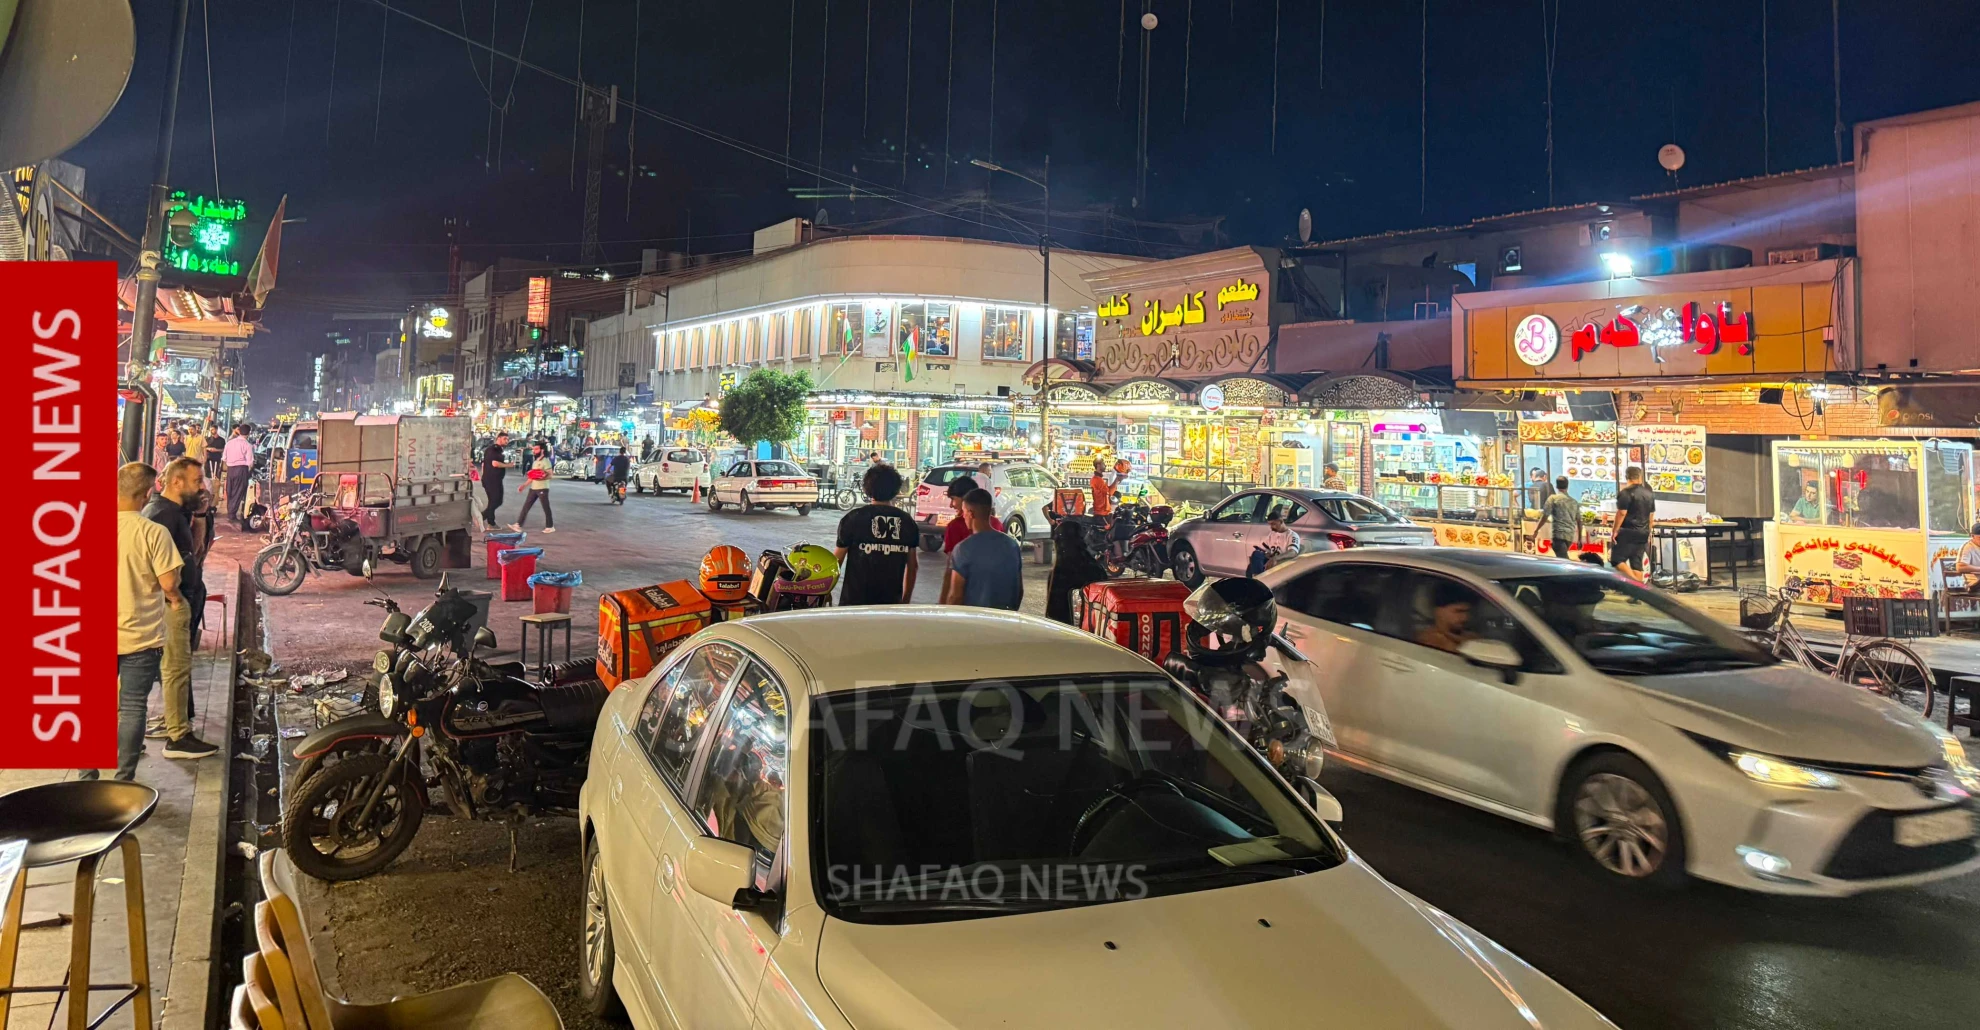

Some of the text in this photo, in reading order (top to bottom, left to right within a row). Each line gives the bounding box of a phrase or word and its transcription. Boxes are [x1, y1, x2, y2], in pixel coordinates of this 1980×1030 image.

[1098, 293, 1131, 326] كباب
[1217, 278, 1259, 311] مطعم
[1141, 290, 1206, 336] كامران
